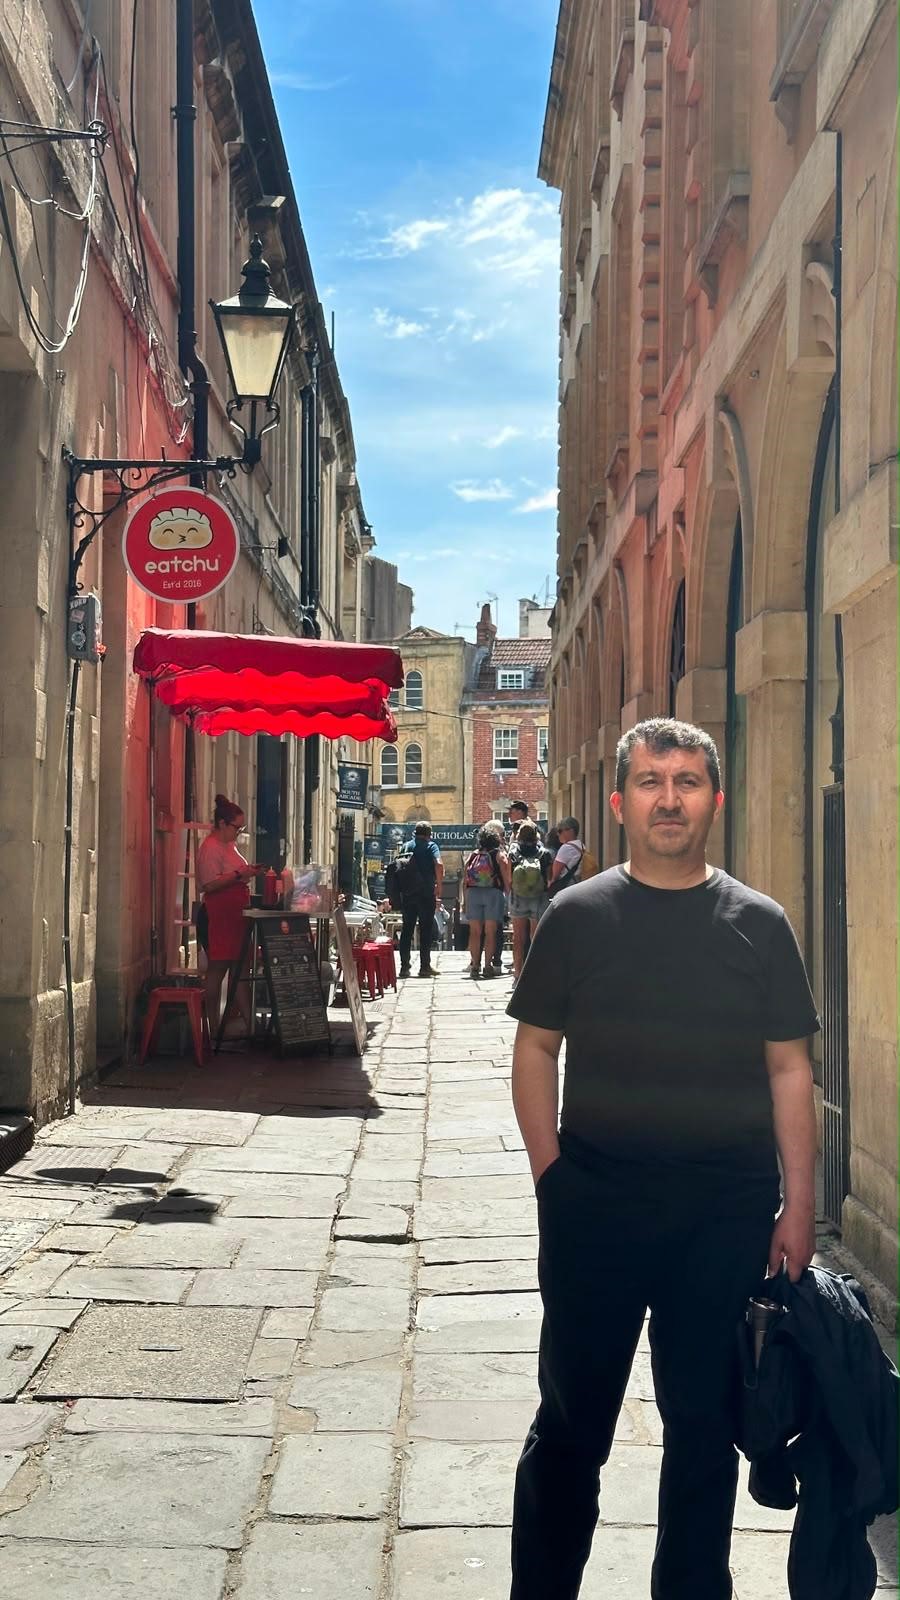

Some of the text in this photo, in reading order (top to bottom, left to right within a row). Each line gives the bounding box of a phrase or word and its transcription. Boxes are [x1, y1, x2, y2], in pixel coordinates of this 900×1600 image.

[145, 554, 219, 574] eatchu
[183, 579, 202, 588] 2016
[340, 788, 360, 796] SOUTH
